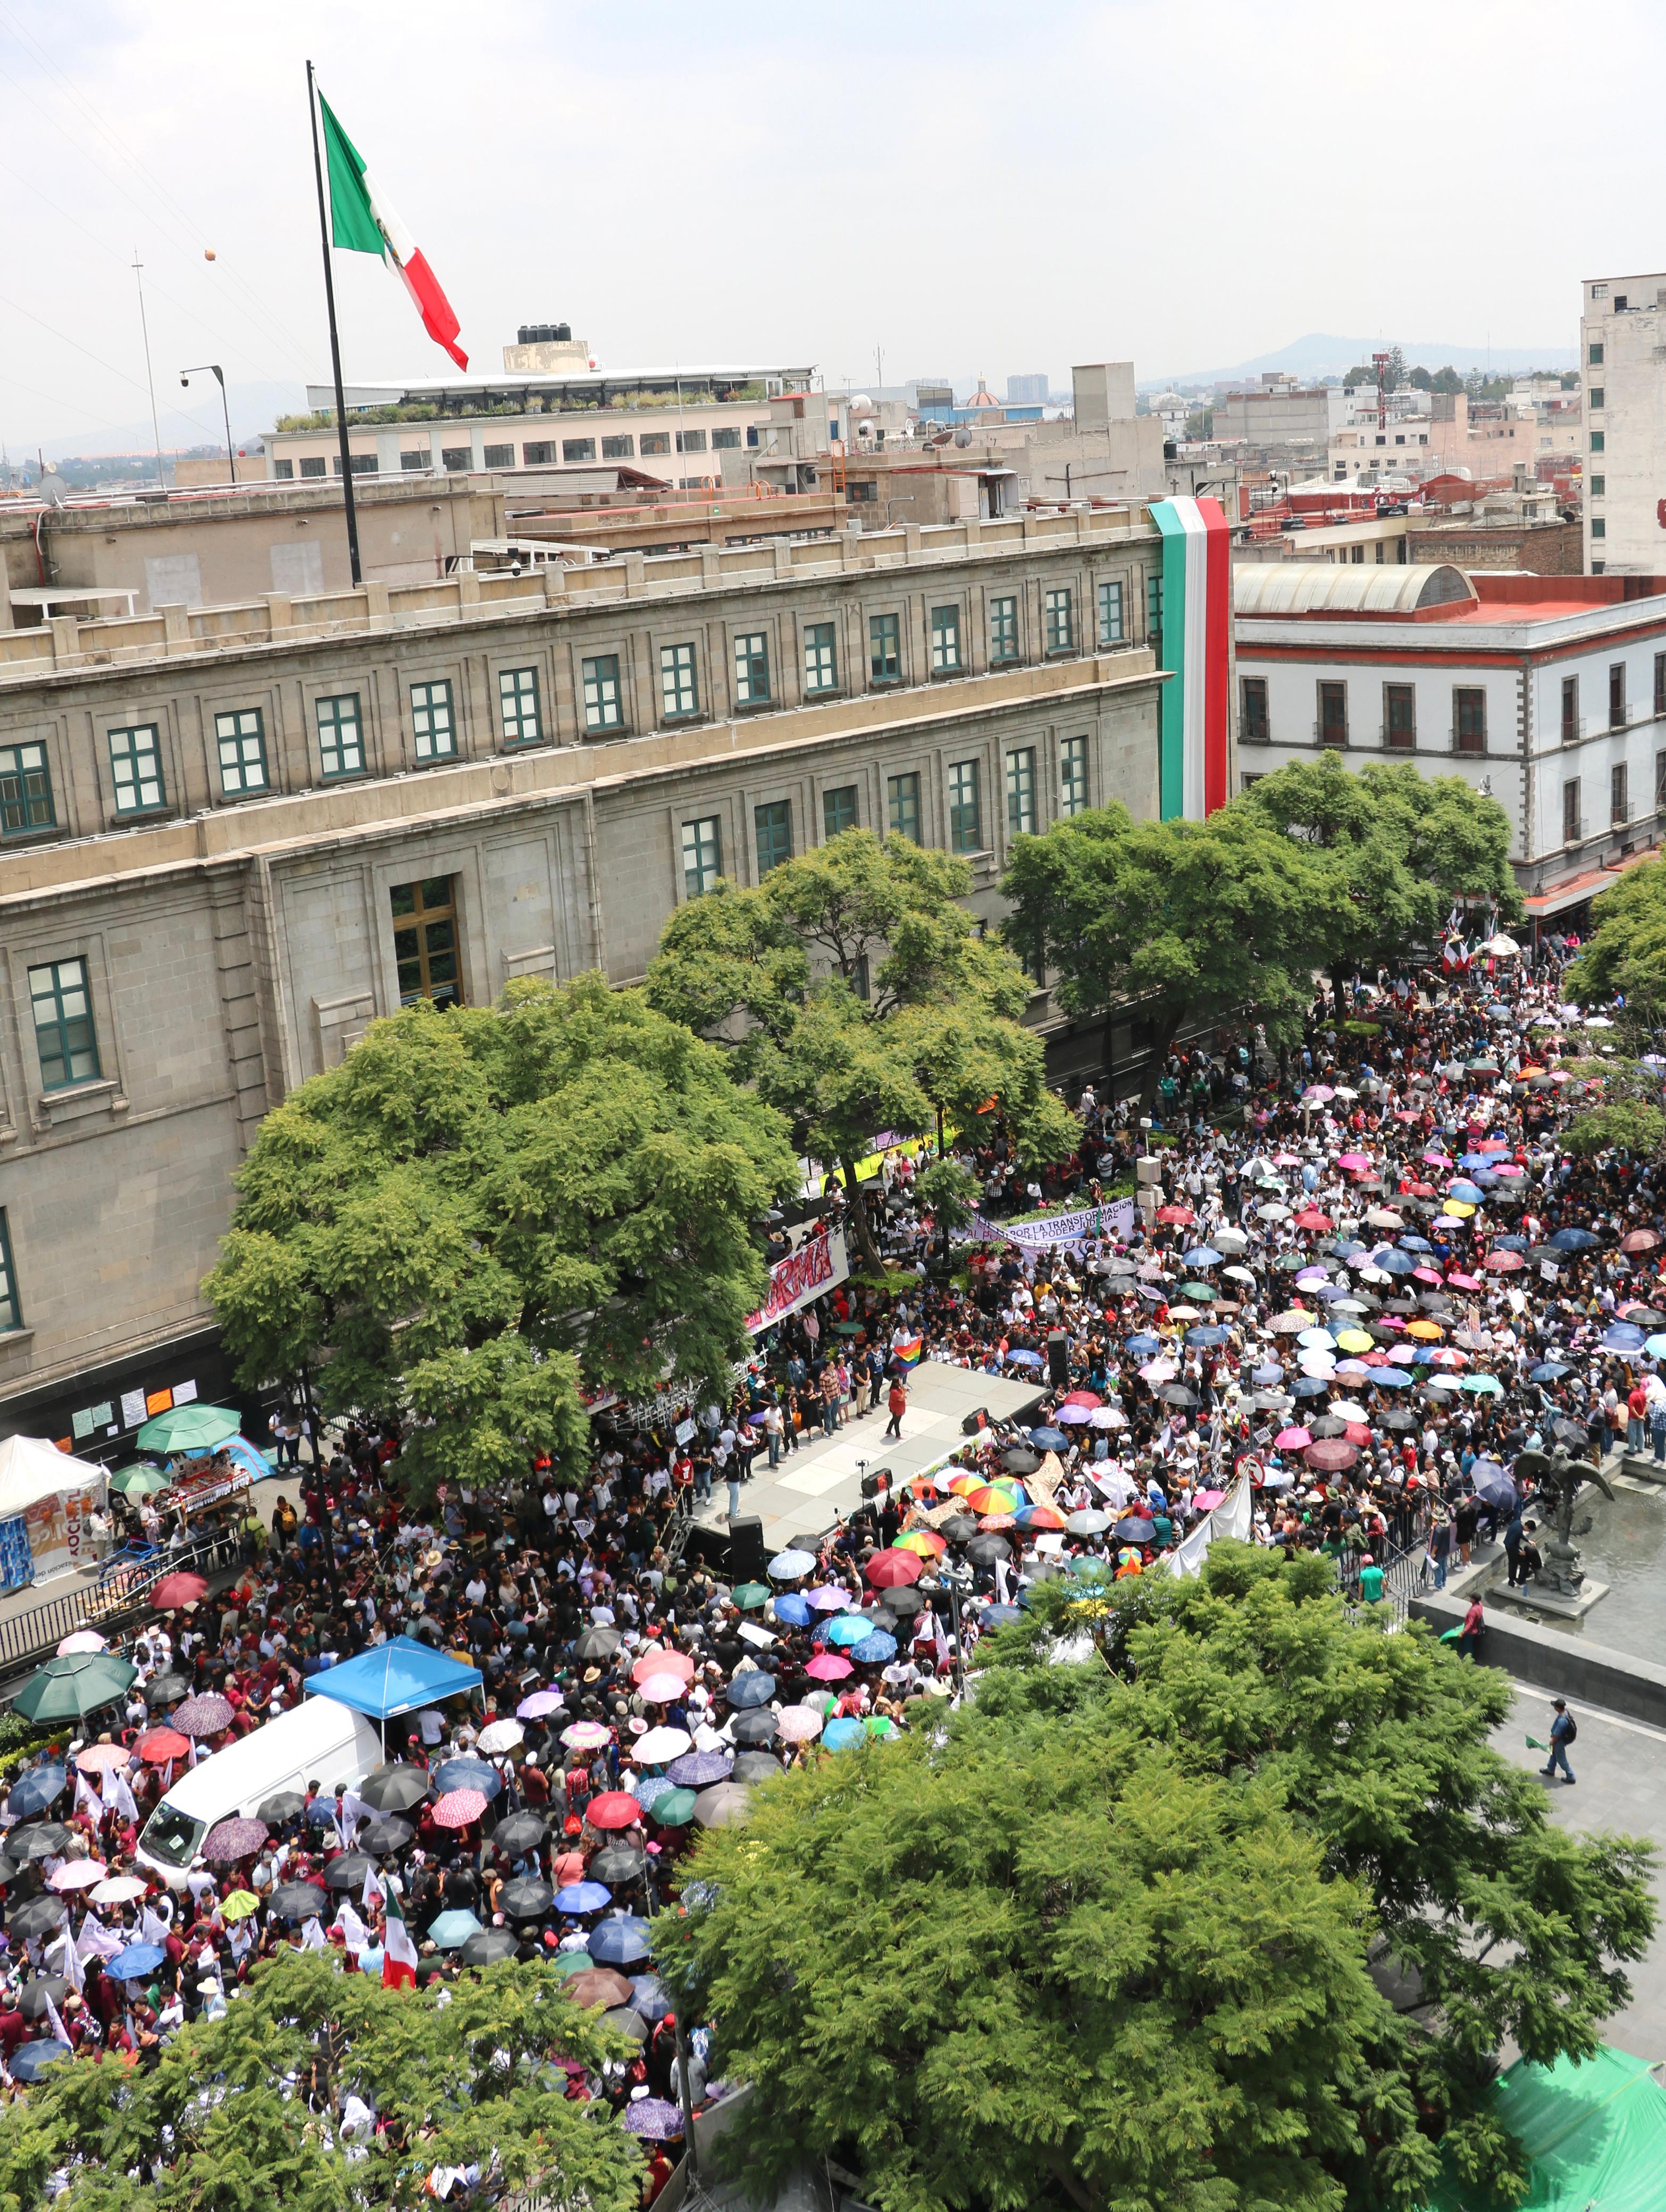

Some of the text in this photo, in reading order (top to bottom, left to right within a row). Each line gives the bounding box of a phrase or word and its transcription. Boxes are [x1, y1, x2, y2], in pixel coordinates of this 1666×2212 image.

[966, 1229, 979, 1239] AL
[1010, 1228, 1030, 1237] POR
[1033, 1224, 1046, 1233] LA
[1047, 1201, 1132, 1230] TRANSFORMACIÓN
[1042, 1226, 1075, 1239] PODER
[1078, 1213, 1118, 1230] JUDICIAL
[743, 1235, 833, 1329] ORMA
